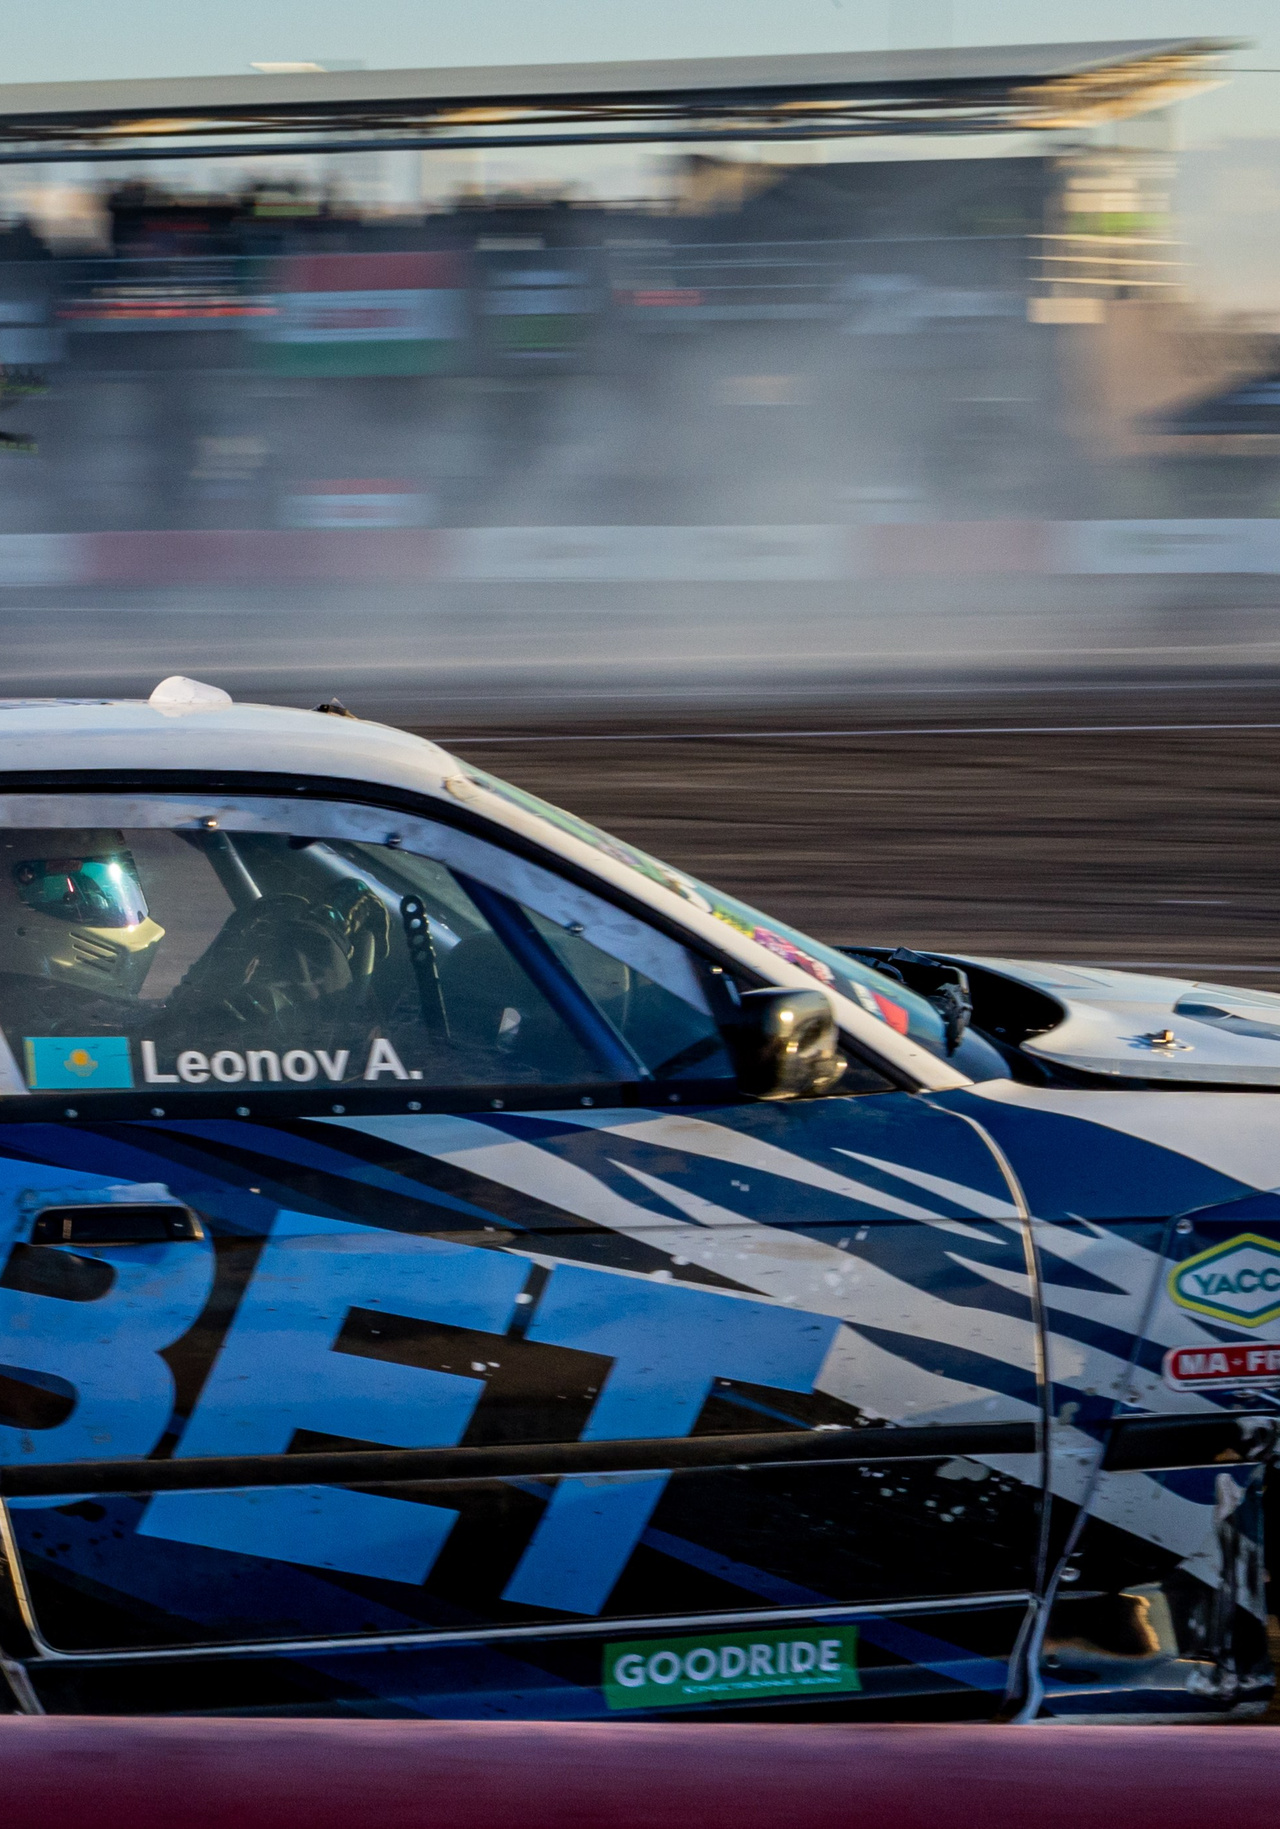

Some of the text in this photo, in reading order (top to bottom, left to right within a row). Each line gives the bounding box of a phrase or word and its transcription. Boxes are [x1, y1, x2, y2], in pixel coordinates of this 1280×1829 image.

[140, 1037, 423, 1083] Leonov A.
[613, 1639, 843, 1688] GOODRIDE
